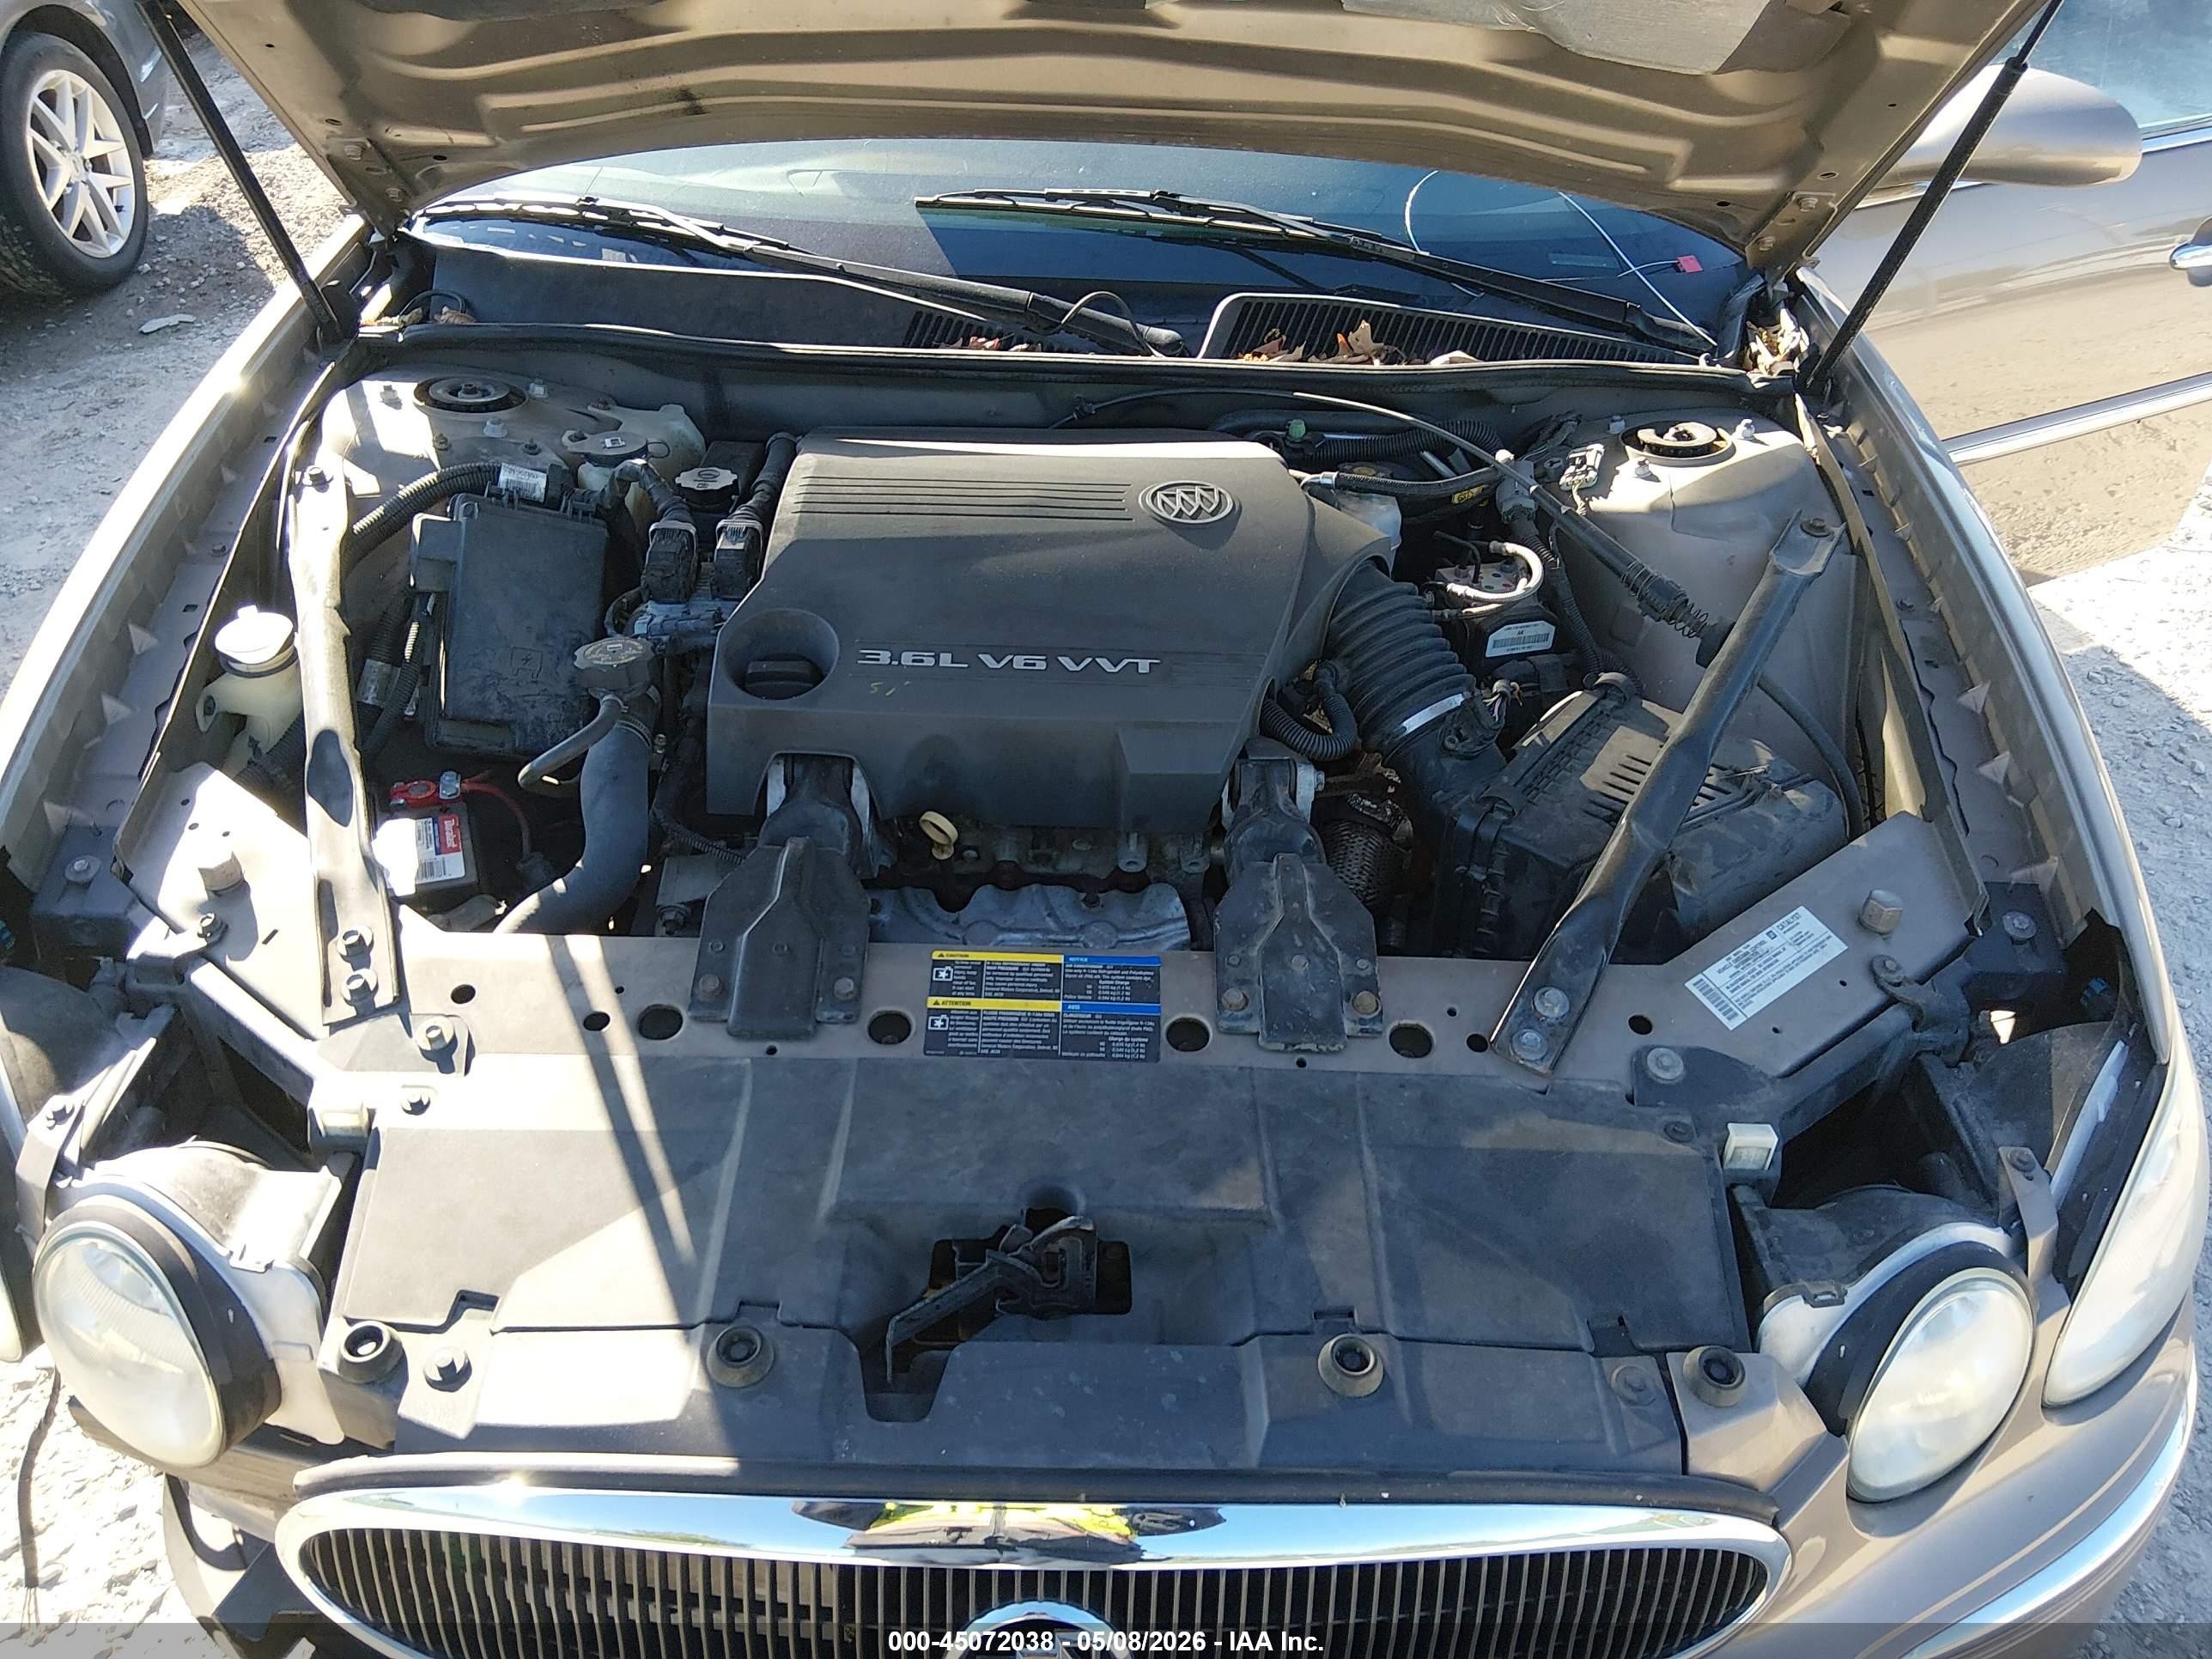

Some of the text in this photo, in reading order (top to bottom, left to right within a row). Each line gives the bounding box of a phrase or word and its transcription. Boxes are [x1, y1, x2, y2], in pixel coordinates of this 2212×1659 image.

[857, 649, 1161, 674] 3.6L V6 VVT
[1776, 912, 1802, 931] CATALYST
